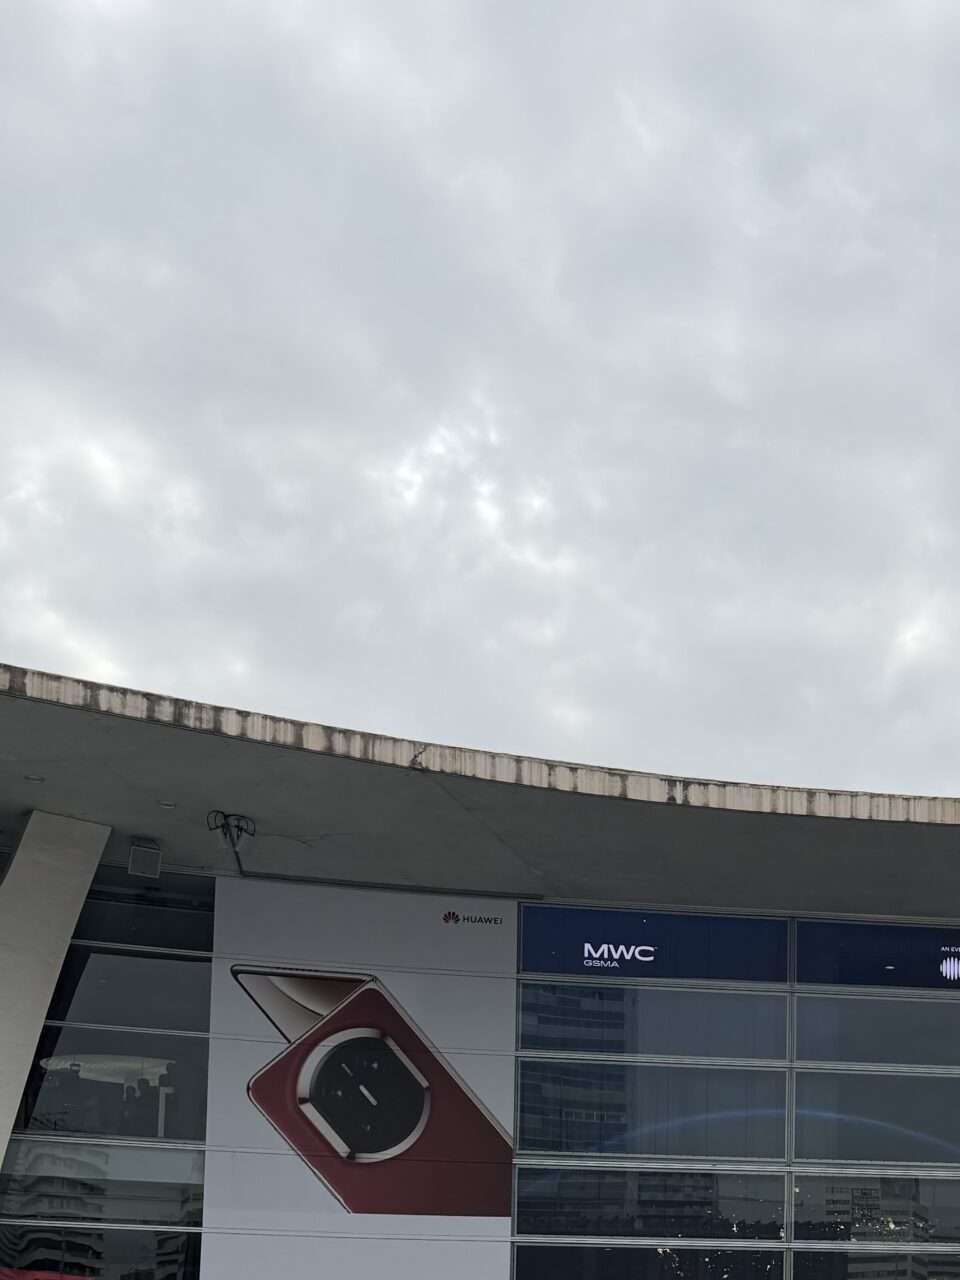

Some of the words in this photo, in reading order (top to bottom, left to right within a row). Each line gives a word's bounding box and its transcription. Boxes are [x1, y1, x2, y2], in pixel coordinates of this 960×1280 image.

[462, 916, 503, 925] HUAWEI
[583, 943, 655, 961] MWC
[583, 959, 620, 968] GSMA
